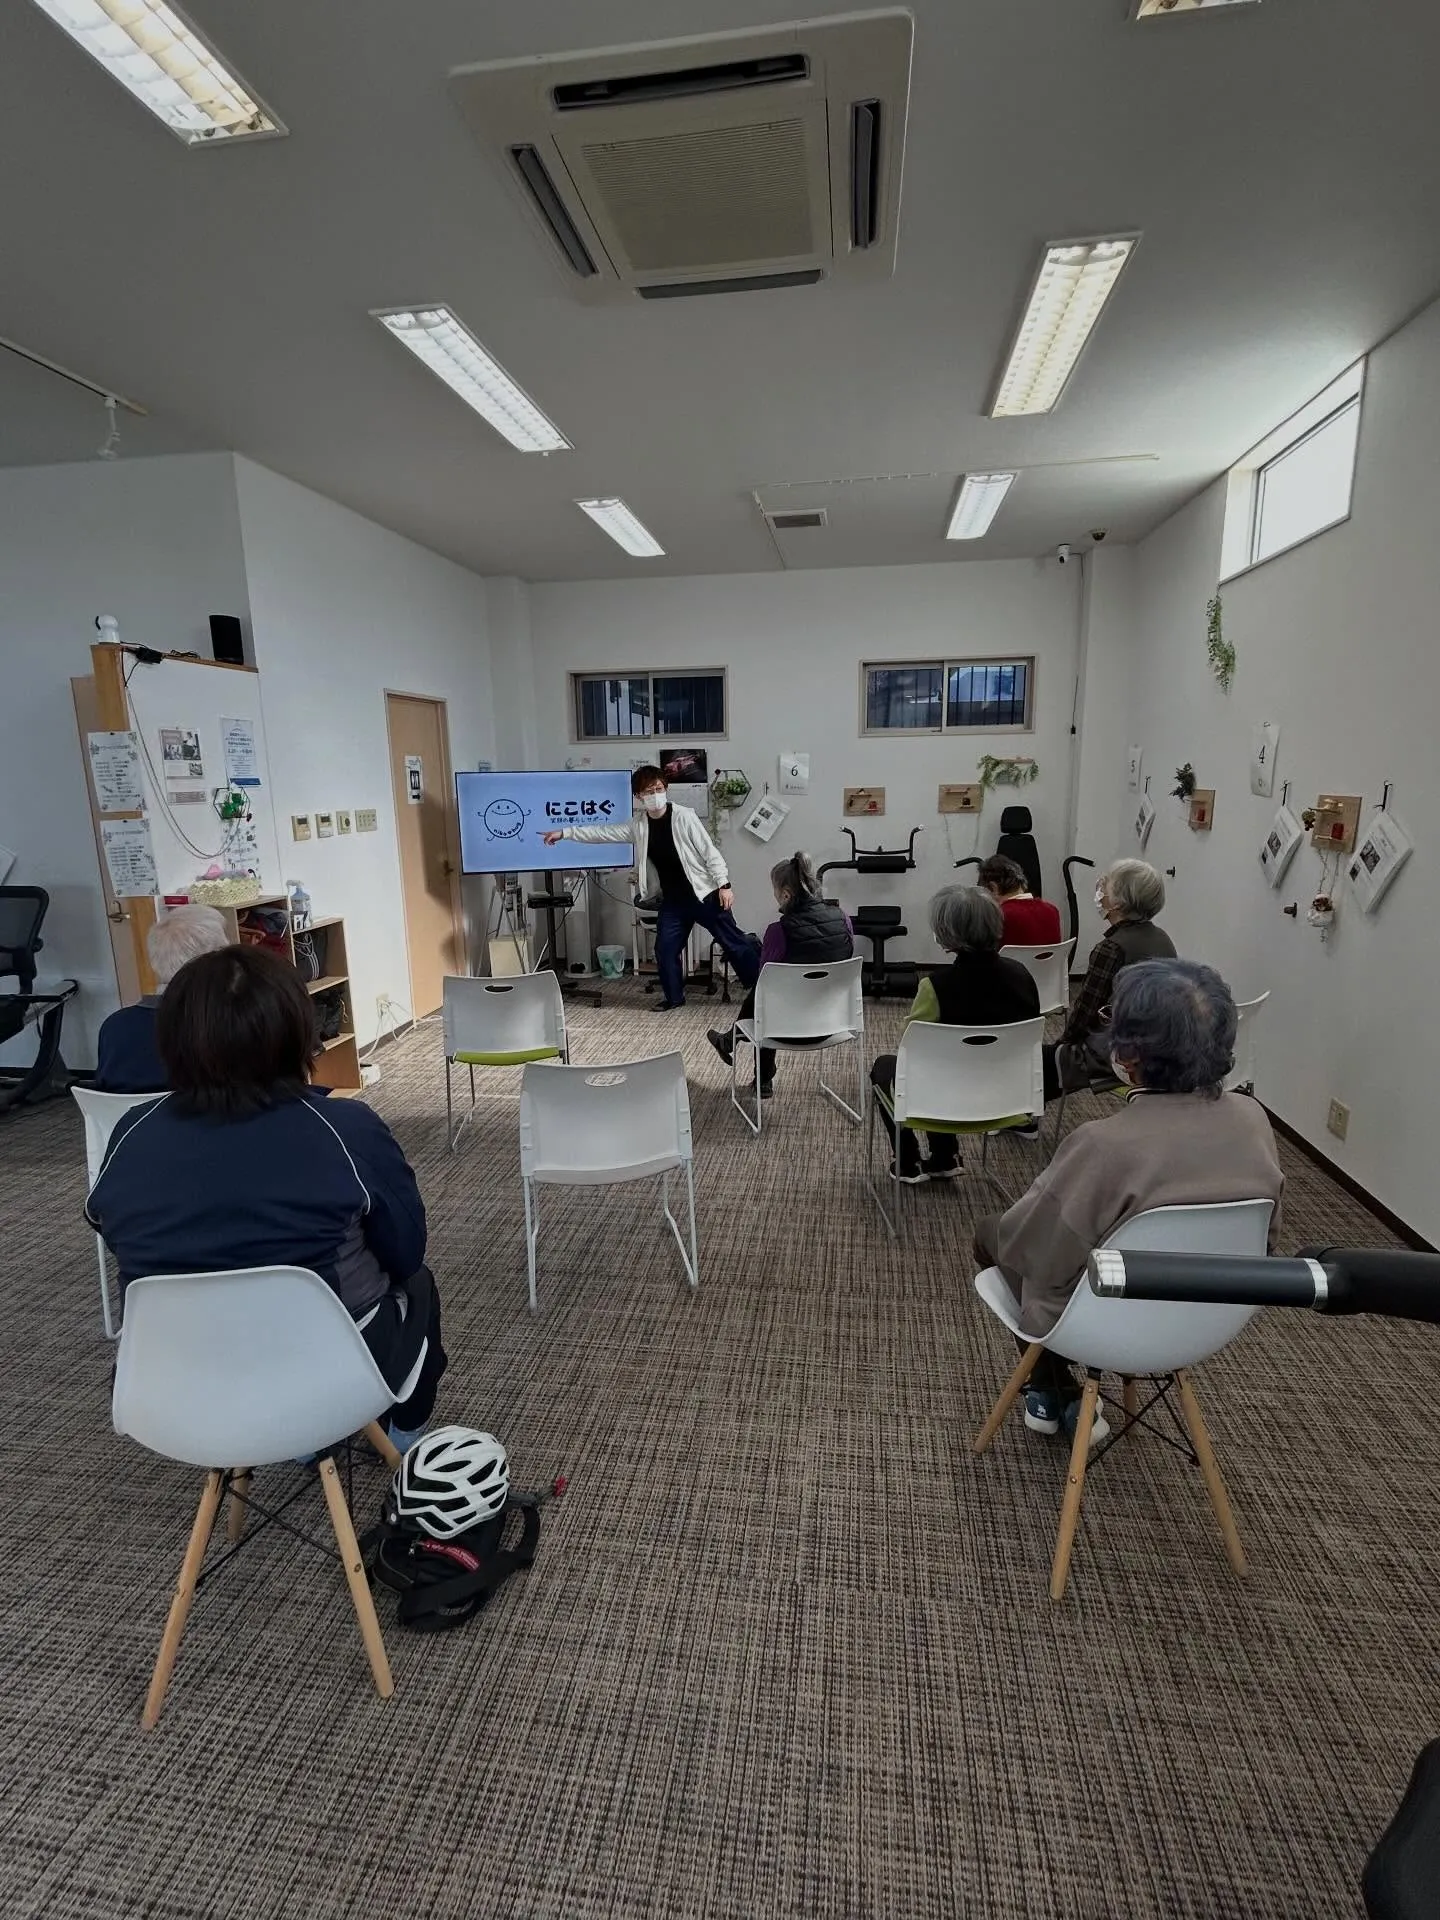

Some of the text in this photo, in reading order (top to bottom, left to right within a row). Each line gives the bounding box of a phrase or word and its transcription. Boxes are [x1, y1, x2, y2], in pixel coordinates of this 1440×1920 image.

[1259, 745, 1265, 764] 4
[791, 765, 798, 777] 6
[545, 800, 615, 816] にこはぐ
